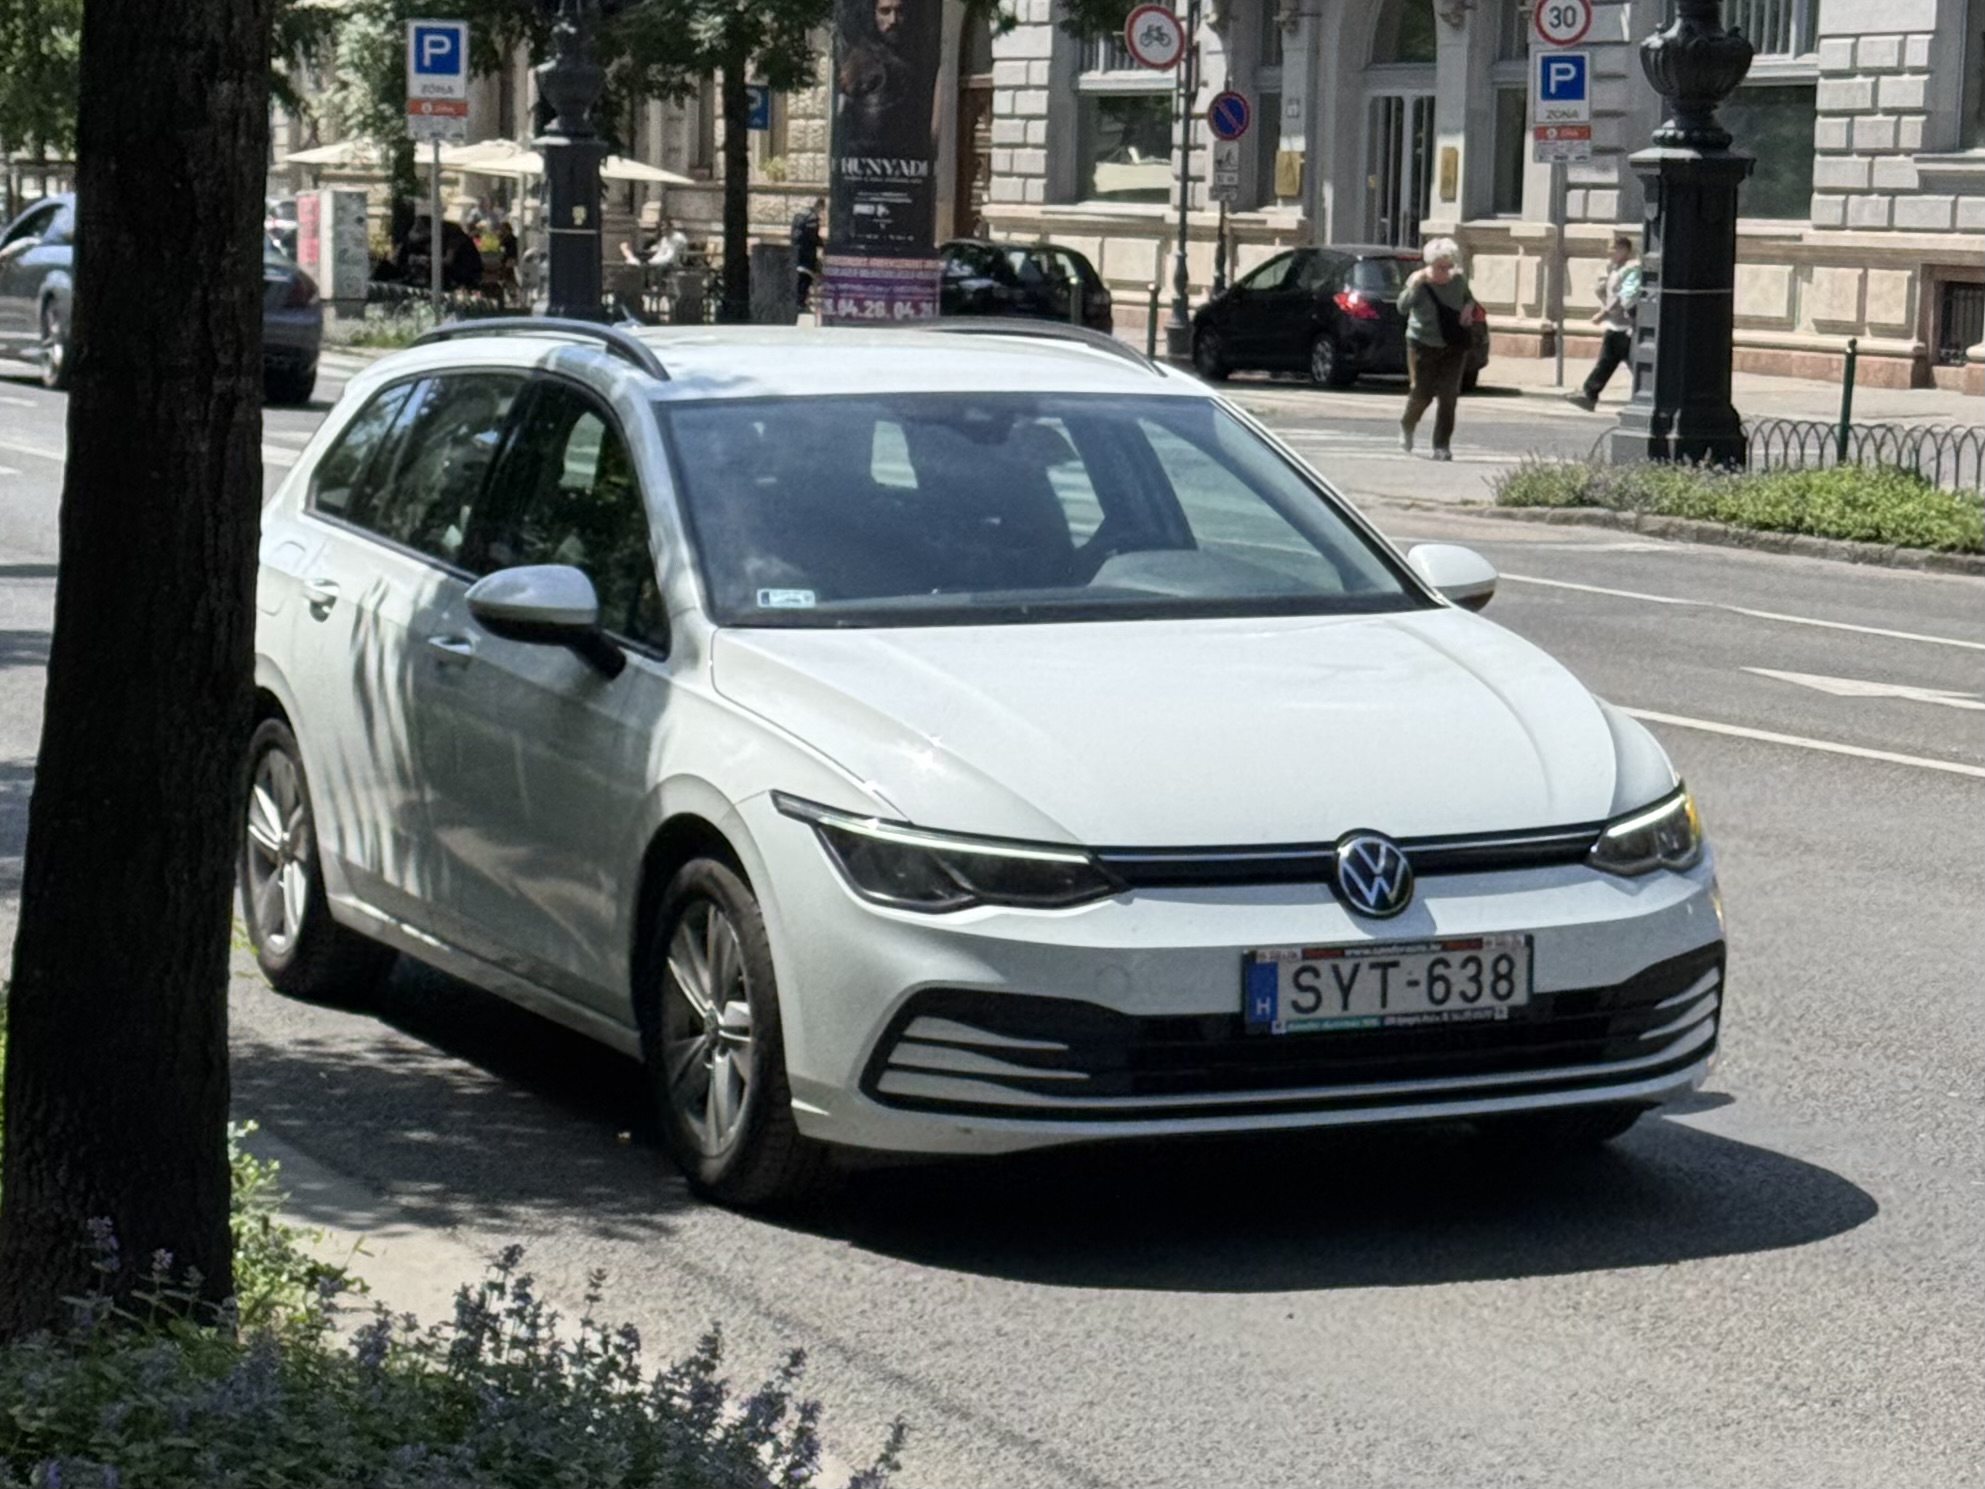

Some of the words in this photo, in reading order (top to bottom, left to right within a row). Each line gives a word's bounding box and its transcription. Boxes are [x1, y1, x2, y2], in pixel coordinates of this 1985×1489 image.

[1549, 5, 1577, 28] 30
[423, 34, 452, 67] P
[1549, 62, 1577, 95] P
[840, 156, 929, 177] HUNYADI
[1291, 953, 1515, 1015] SYT-638
[1256, 997, 1271, 1016] H
